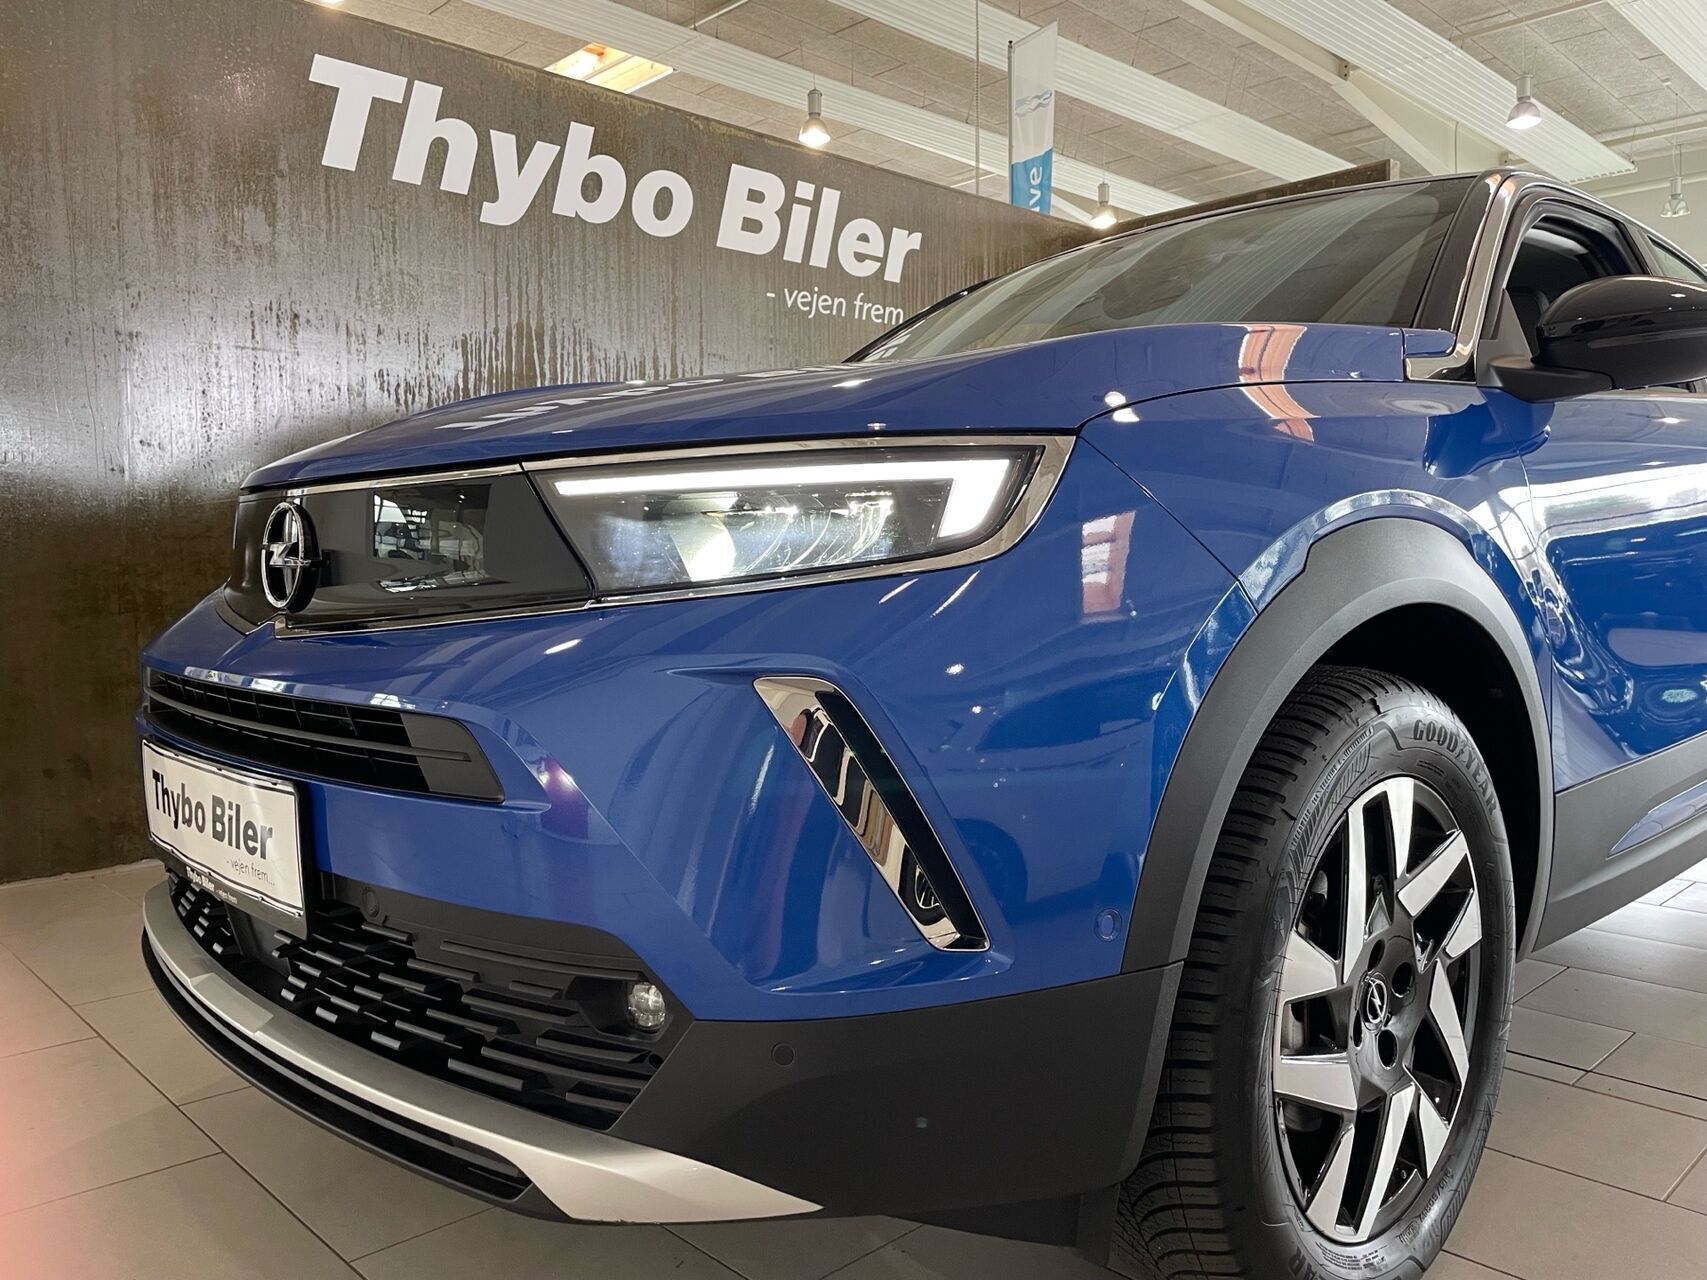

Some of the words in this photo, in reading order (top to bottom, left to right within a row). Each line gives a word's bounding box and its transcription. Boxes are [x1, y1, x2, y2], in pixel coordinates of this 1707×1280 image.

[308, 53, 694, 237] Thybo
[715, 163, 923, 283] Biler
[784, 286, 846, 318] vejen
[853, 292, 904, 325] frem
[1413, 719, 1497, 816] GOODYEAR
[152, 769, 206, 834] Thybo
[212, 795, 273, 860] Biler
[185, 866, 201, 885] Thybo
[202, 875, 215, 892] Biler
[230, 858, 250, 875] vejen
